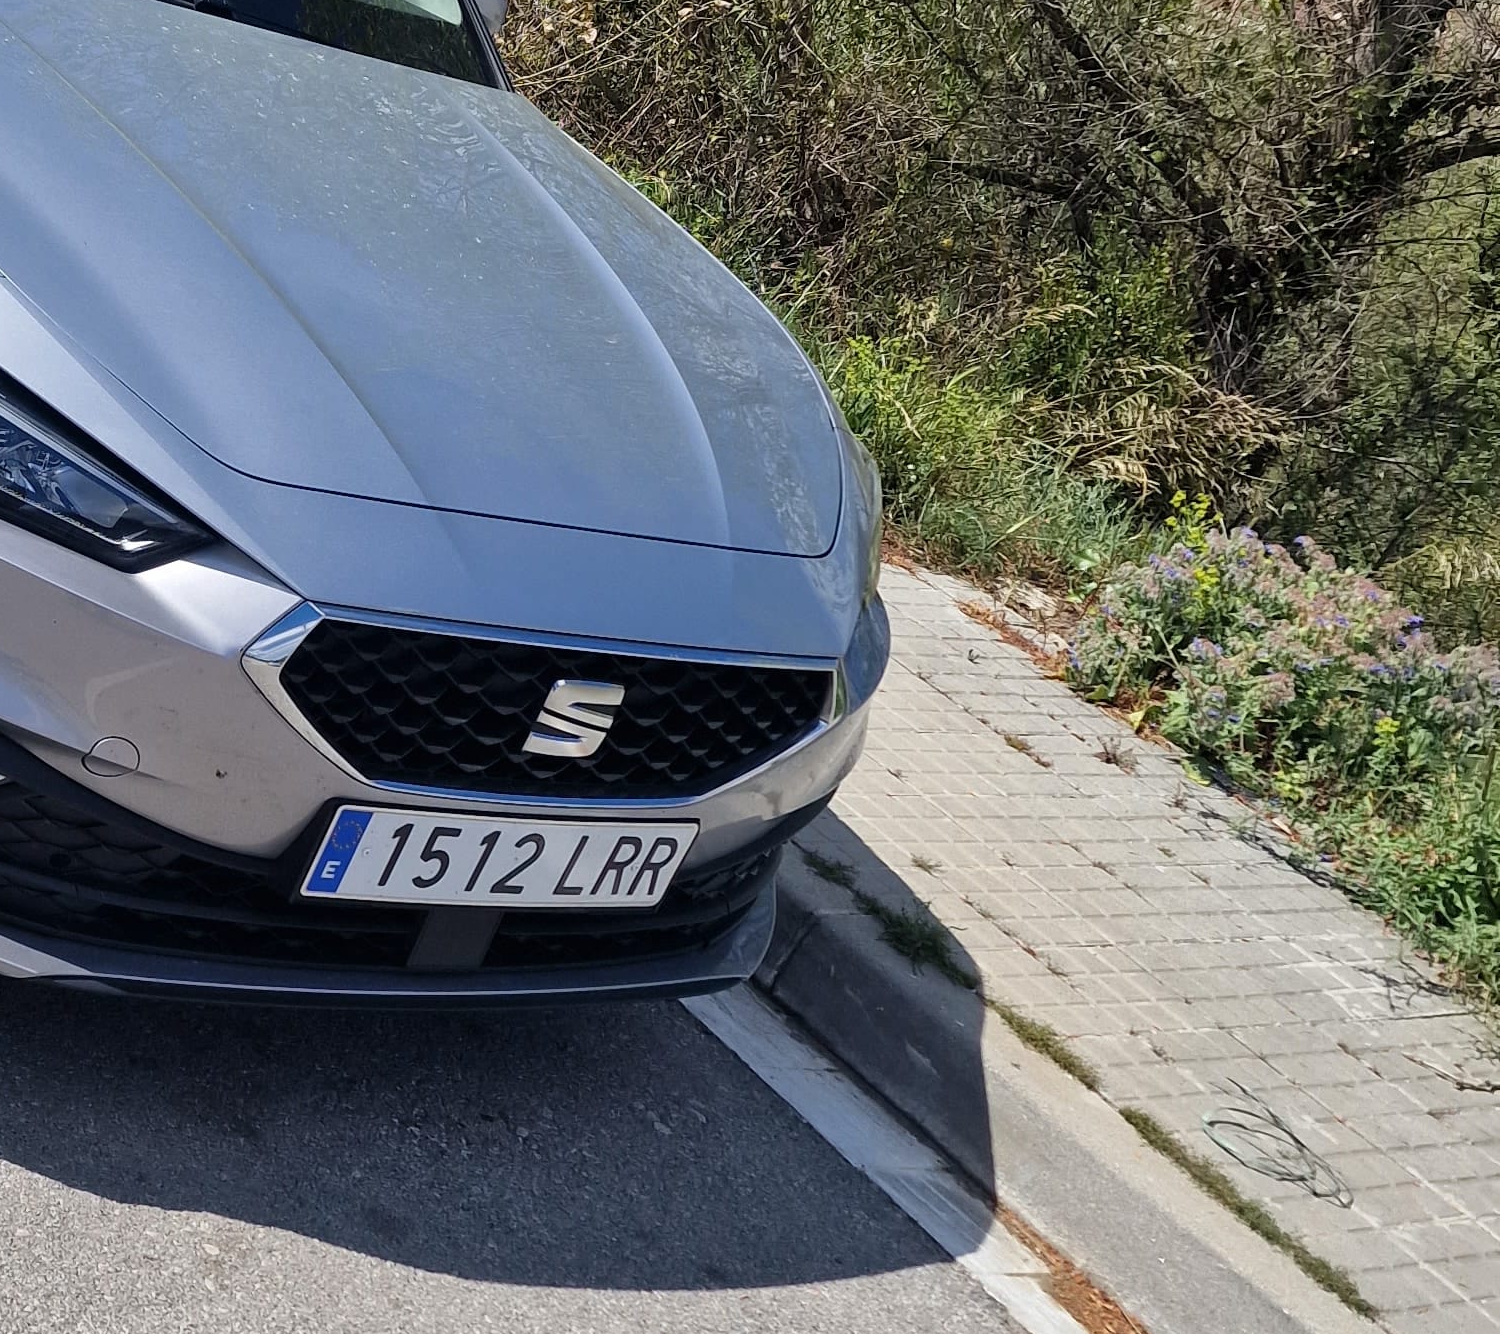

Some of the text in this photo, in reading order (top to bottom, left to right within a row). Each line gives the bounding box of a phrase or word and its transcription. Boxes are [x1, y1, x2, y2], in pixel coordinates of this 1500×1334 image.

[320, 860, 341, 879] E
[377, 823, 679, 896] 1512 LRR
